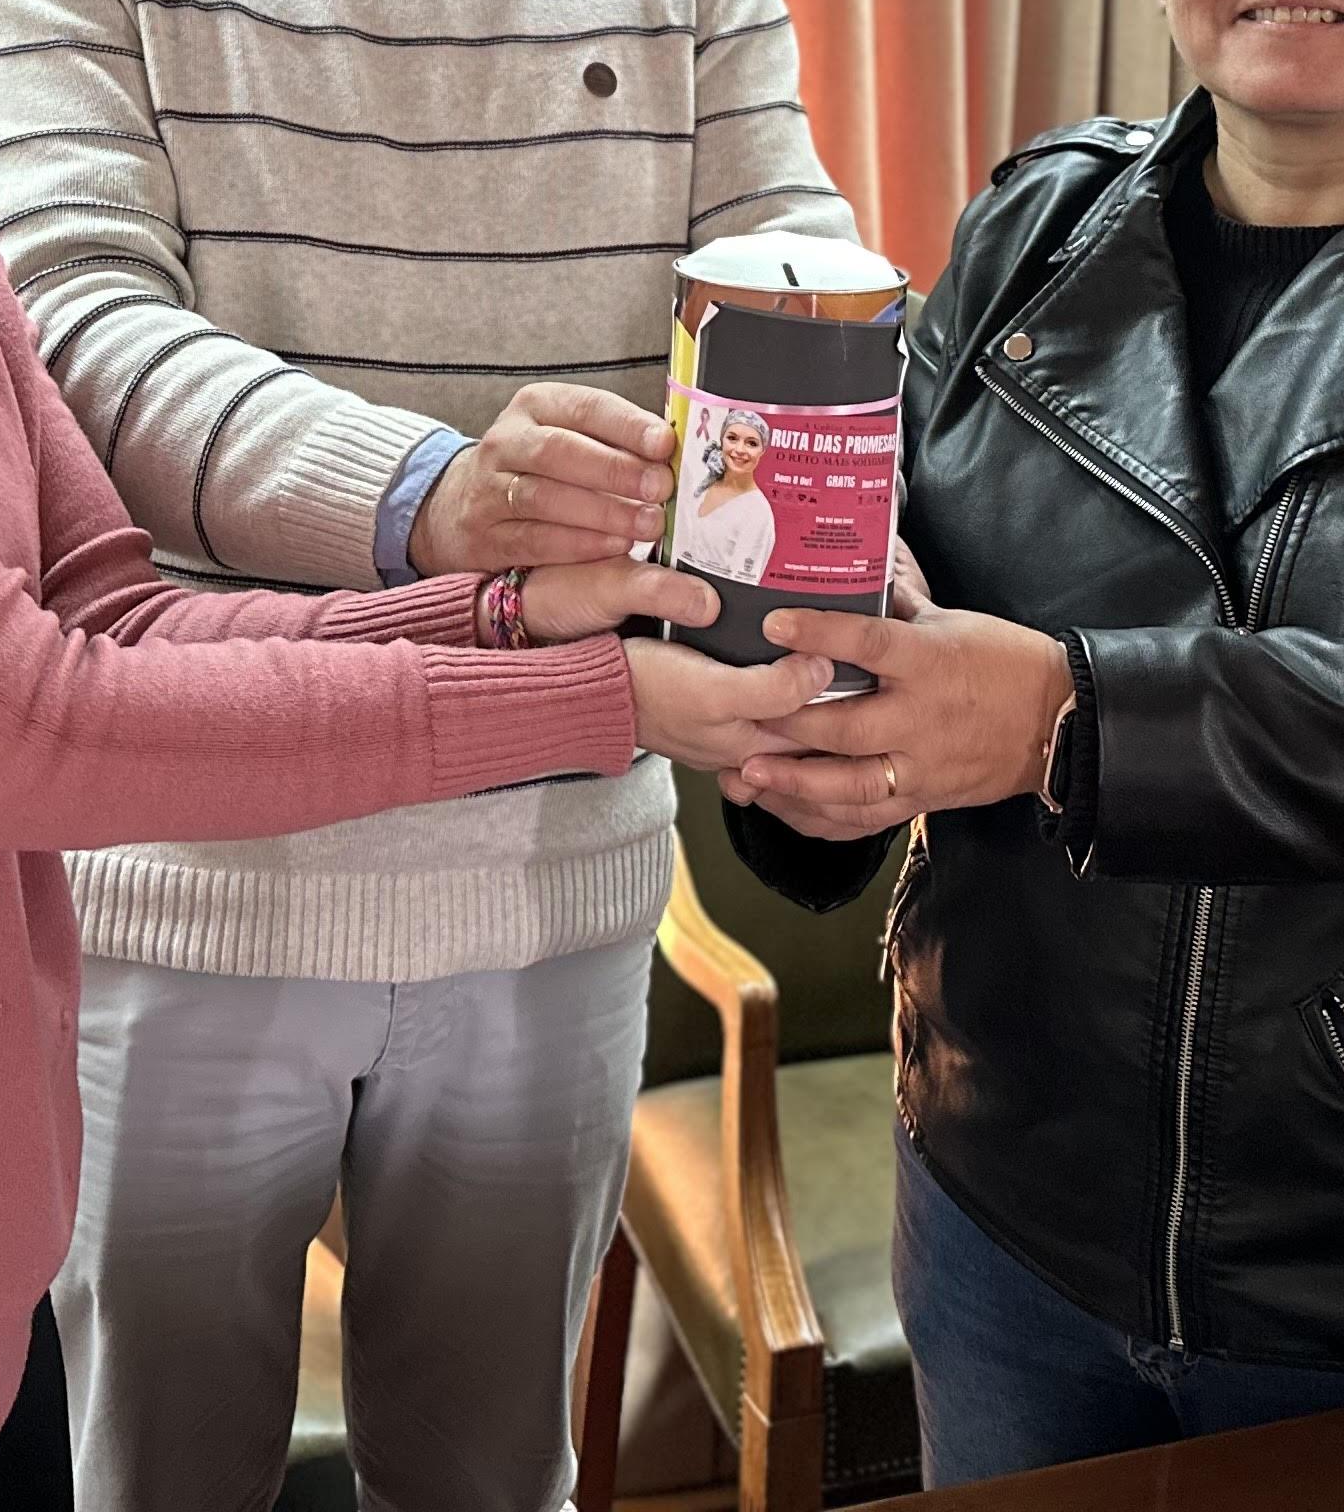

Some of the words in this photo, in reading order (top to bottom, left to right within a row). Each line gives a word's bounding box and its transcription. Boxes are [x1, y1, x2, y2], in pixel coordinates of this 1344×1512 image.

[771, 429, 810, 451] RUTA
[813, 433, 843, 454] DAS
[845, 433, 896, 454] PROMESAS
[788, 453, 820, 465] RETO
[826, 474, 856, 488] GRATIS
